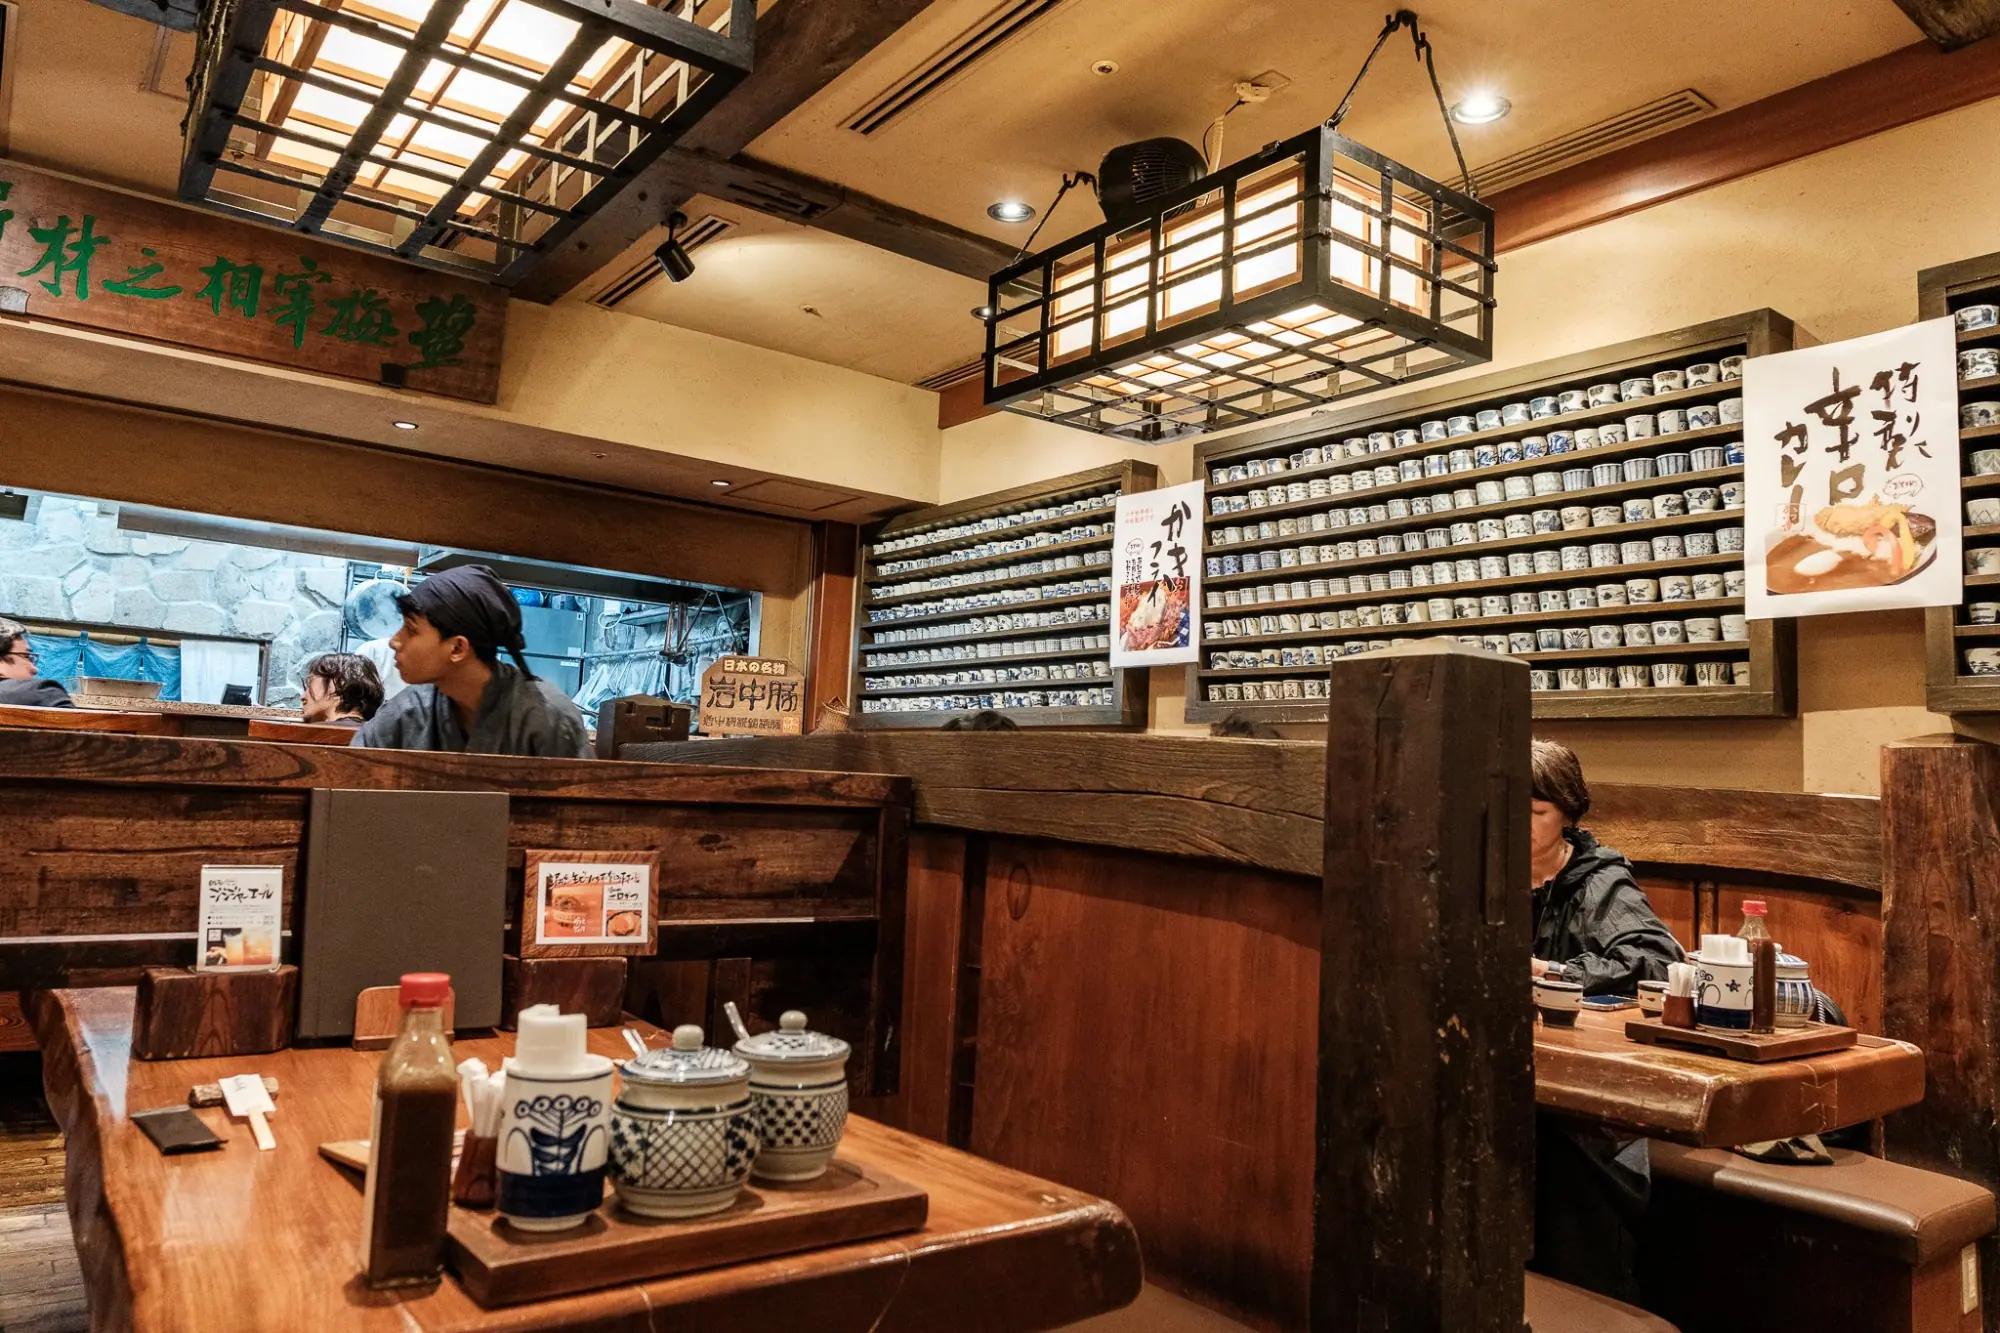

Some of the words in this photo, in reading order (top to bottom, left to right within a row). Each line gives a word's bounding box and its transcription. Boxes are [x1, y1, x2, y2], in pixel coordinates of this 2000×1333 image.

[1774, 421, 1808, 524] カレー
[1804, 367, 1865, 505] 辛口
[1161, 500, 1191, 576] かき
[724, 660, 785, 675] 日本の名物
